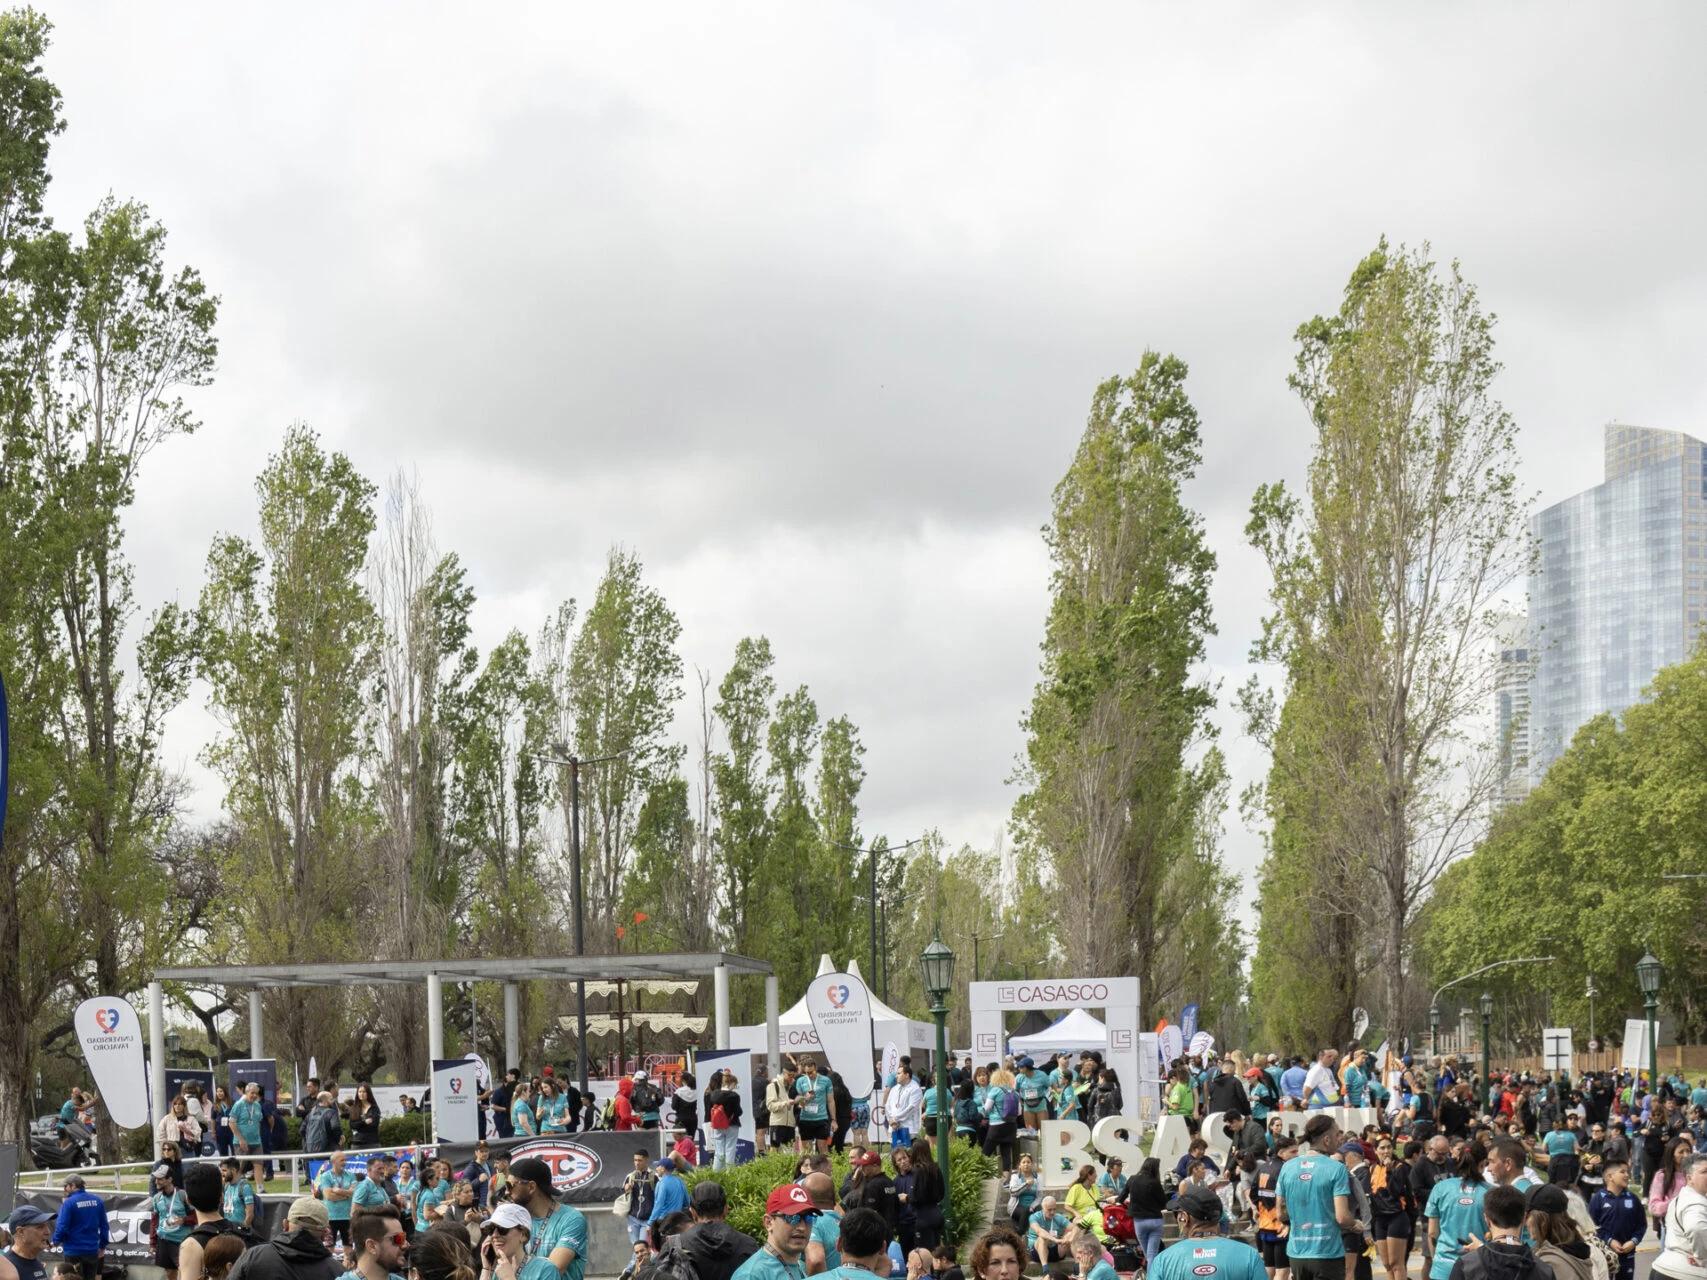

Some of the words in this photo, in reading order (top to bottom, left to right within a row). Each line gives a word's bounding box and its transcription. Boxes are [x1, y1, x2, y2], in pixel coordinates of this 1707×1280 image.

[1018, 984, 1108, 1003] CASASCO
[789, 1030, 819, 1045] CAS
[124, 1249, 151, 1258] actc.org.
